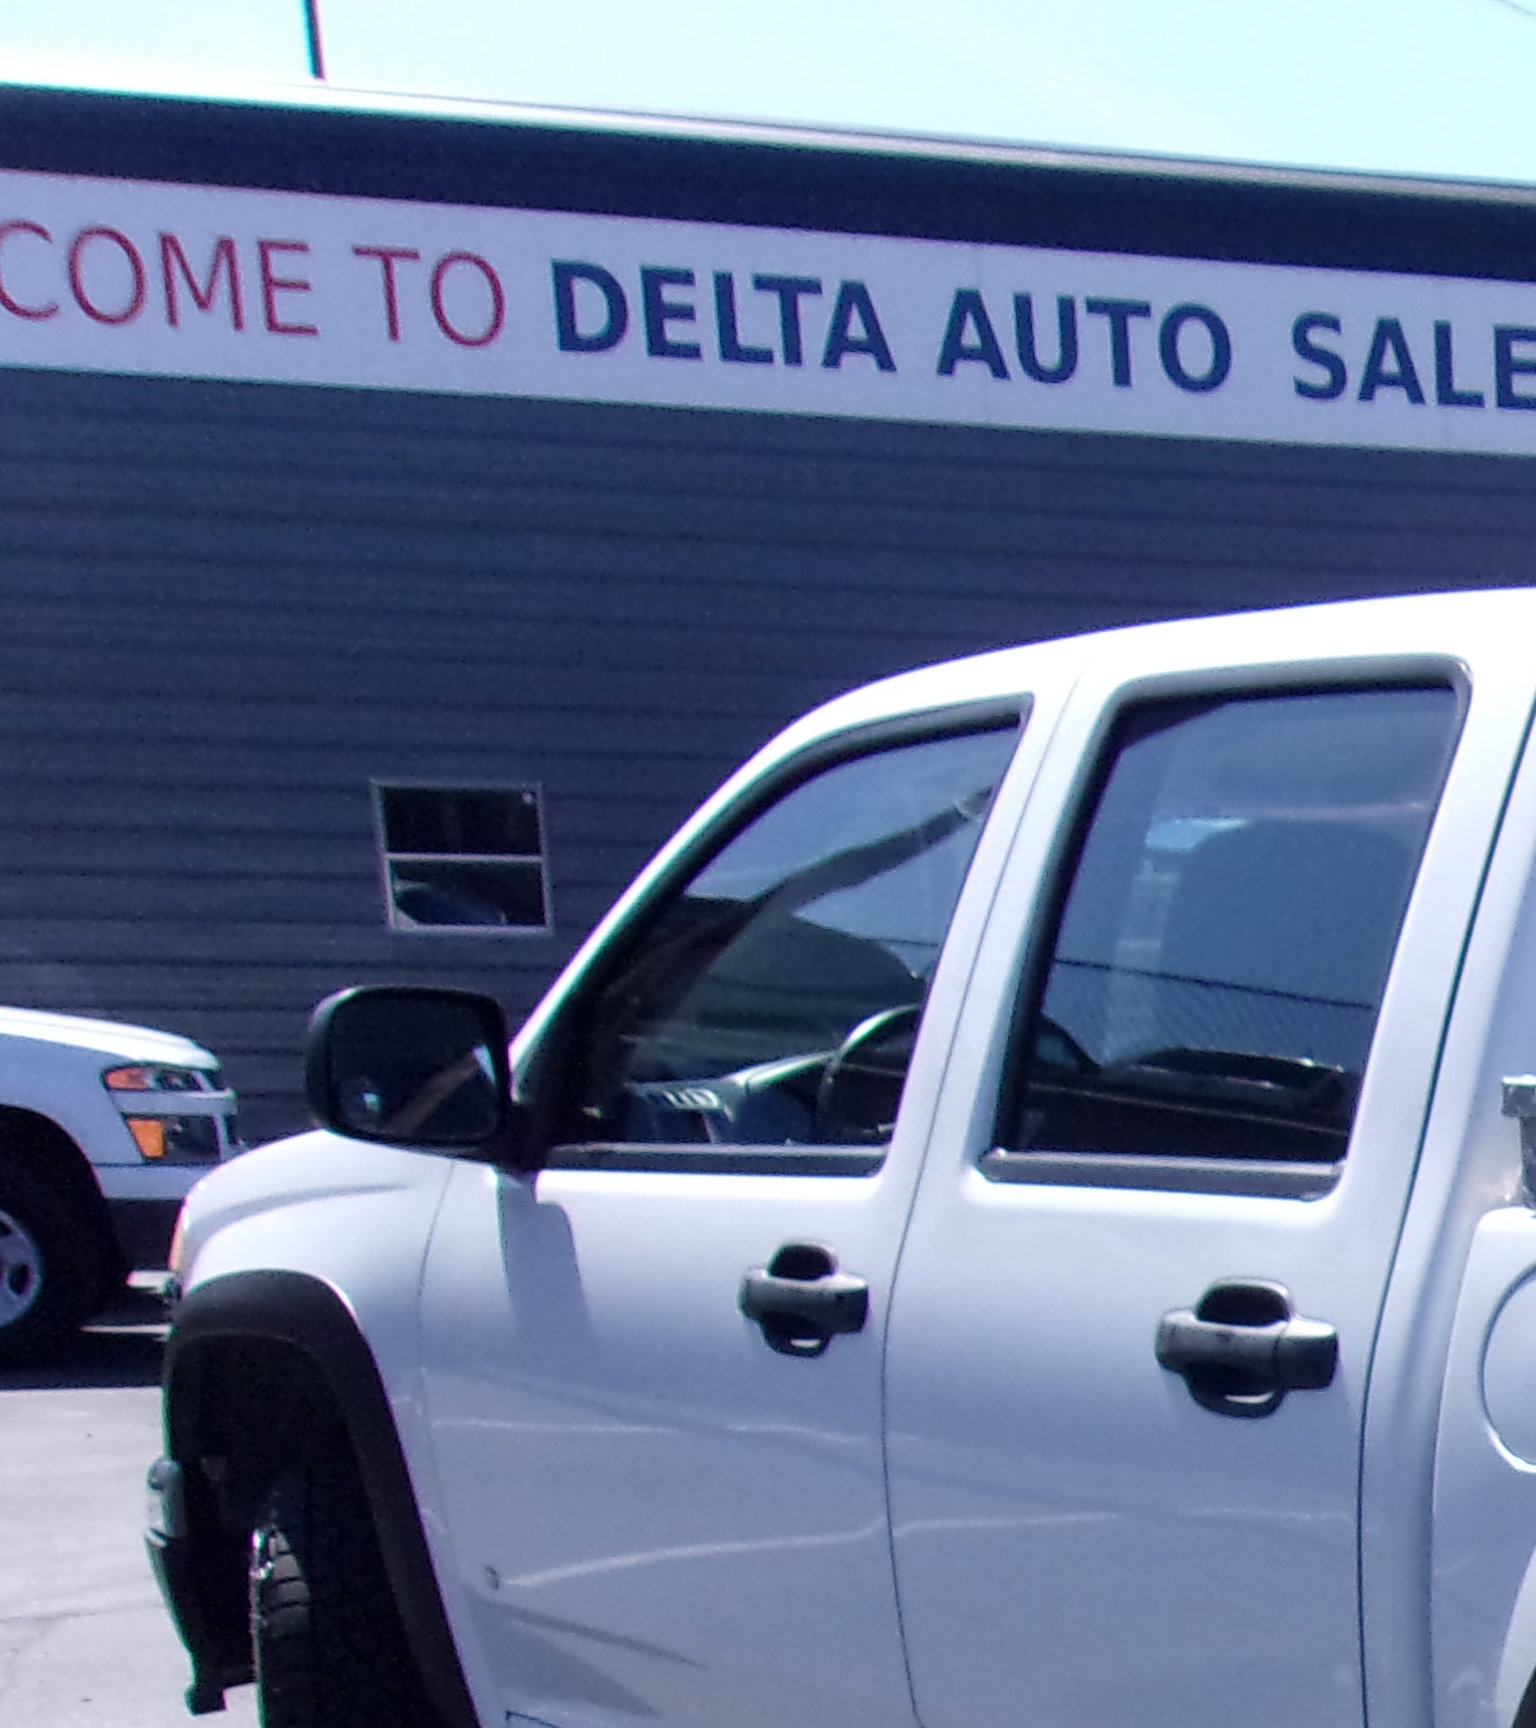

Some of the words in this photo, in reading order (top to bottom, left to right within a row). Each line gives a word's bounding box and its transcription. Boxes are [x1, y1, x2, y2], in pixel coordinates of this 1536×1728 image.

[354, 243, 506, 347] TO
[549, 257, 897, 373] DELTA
[936, 288, 1233, 393] AUTO
